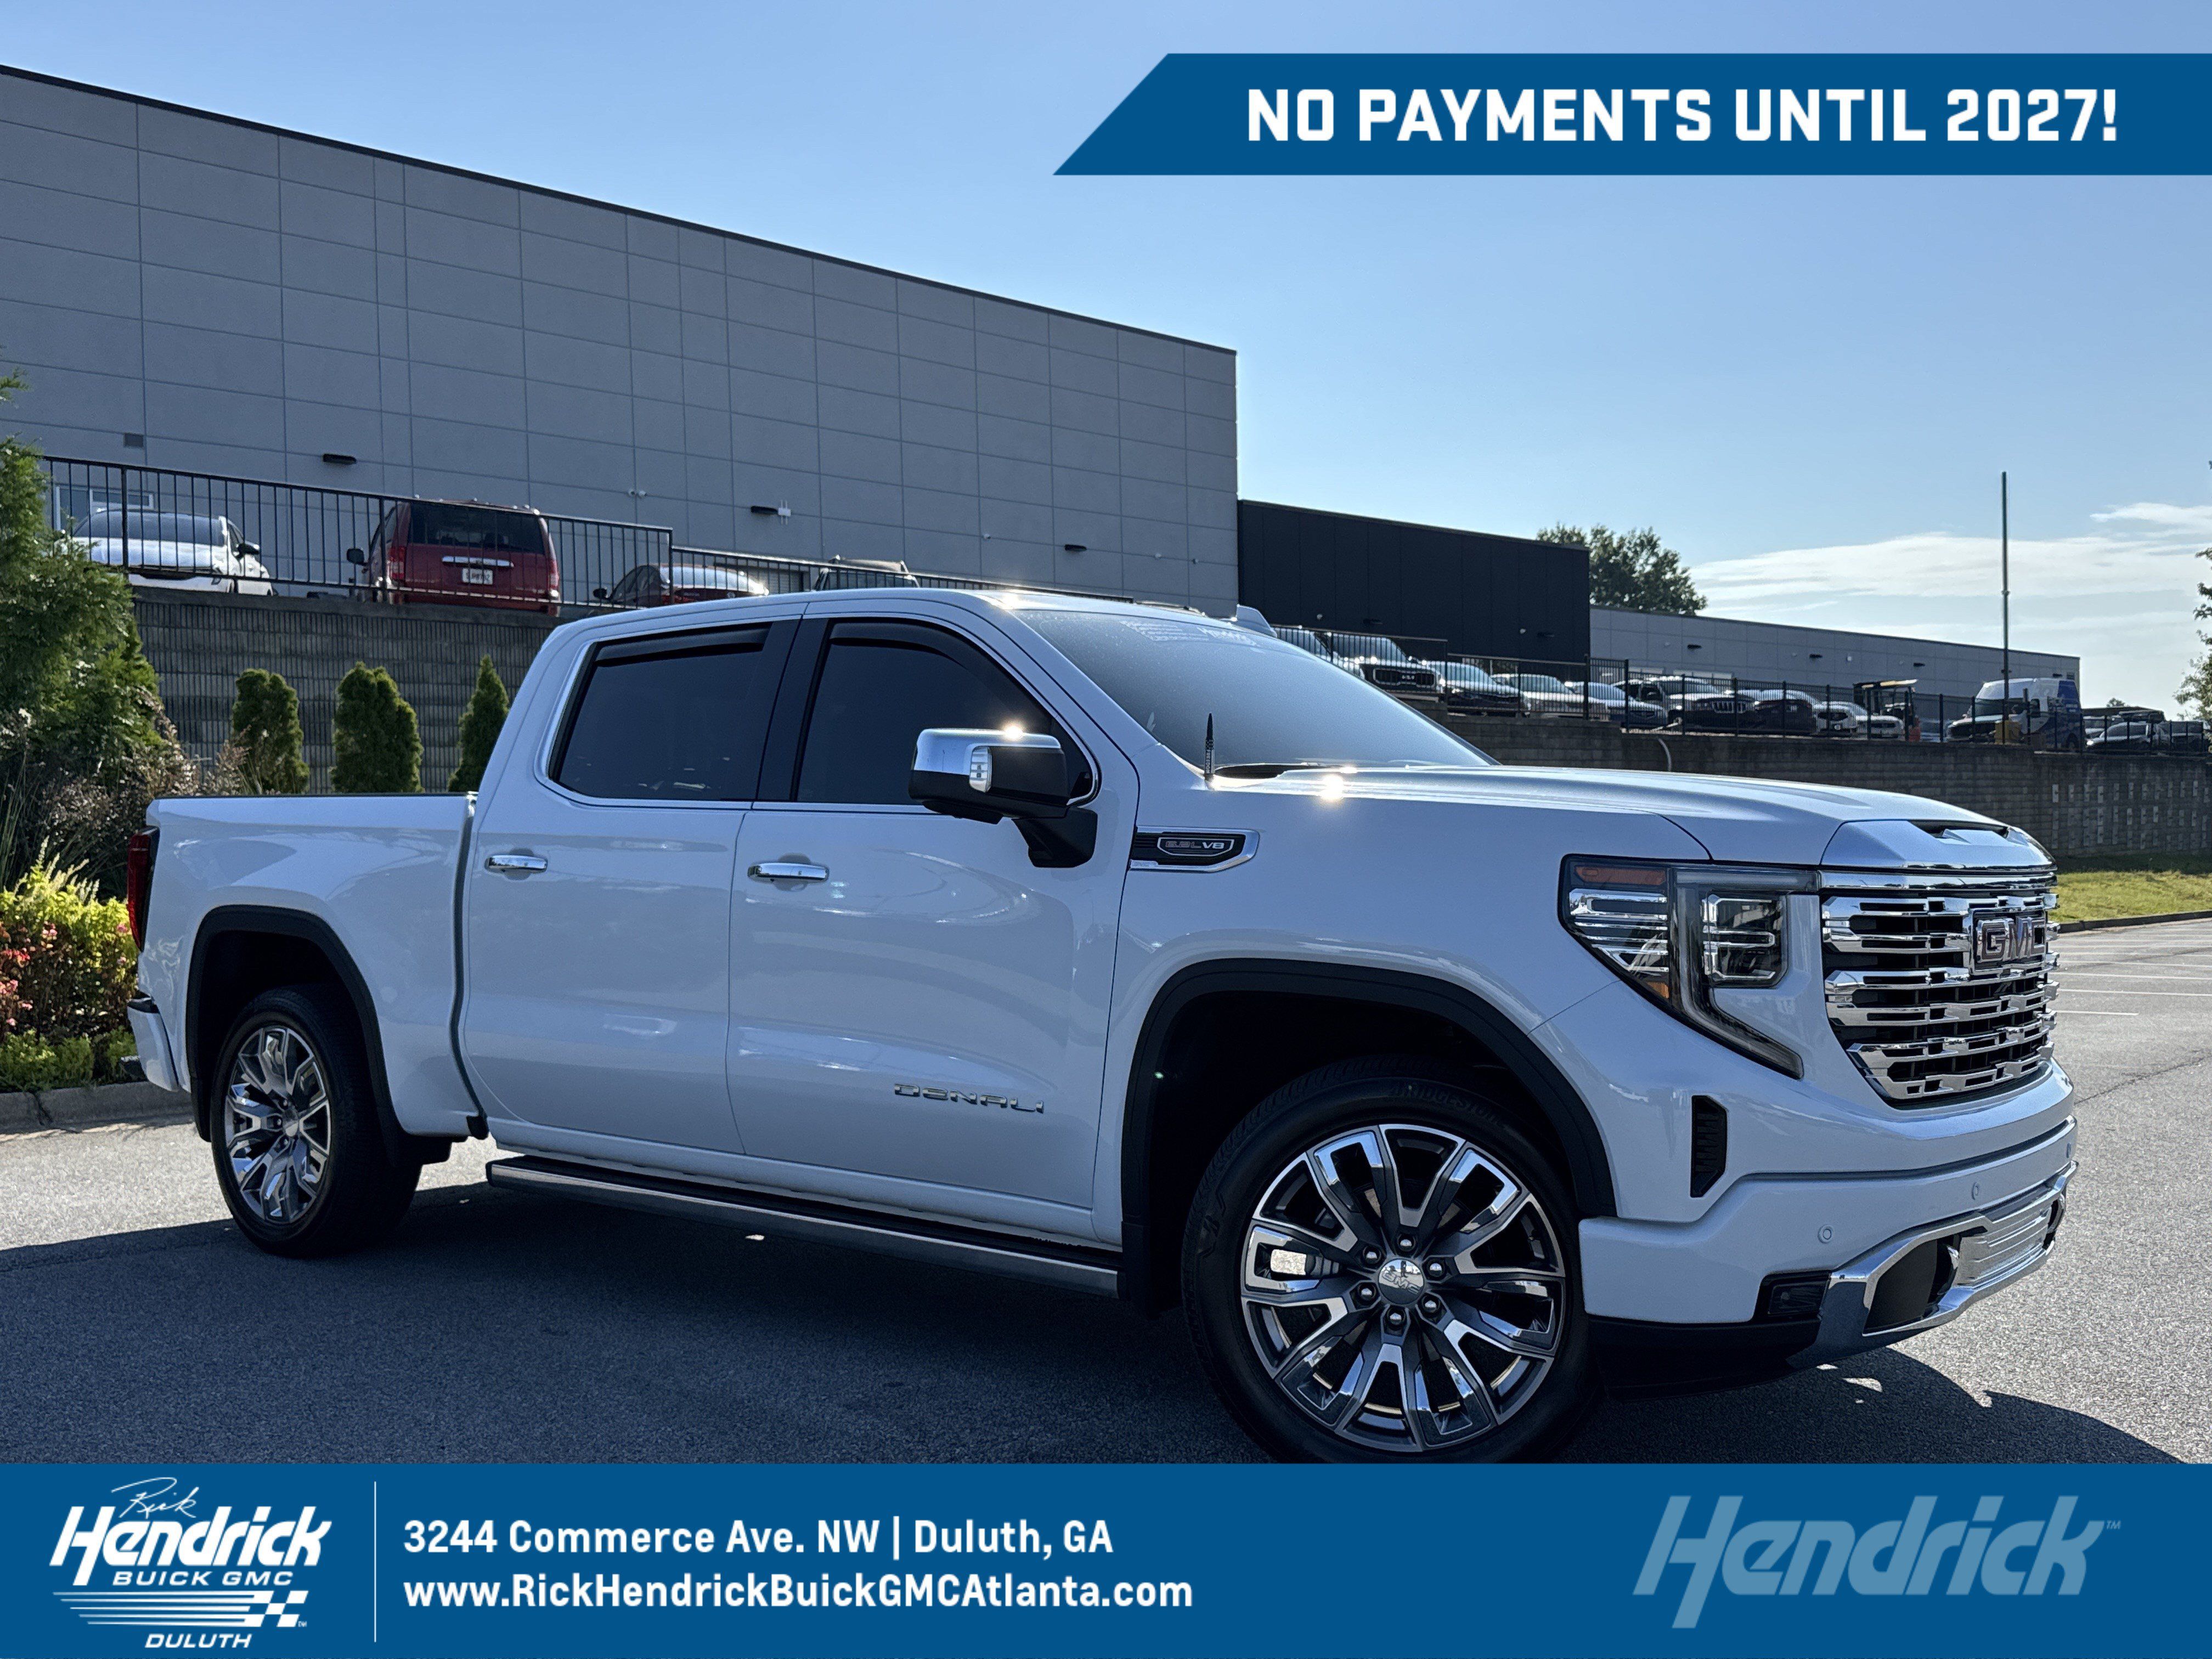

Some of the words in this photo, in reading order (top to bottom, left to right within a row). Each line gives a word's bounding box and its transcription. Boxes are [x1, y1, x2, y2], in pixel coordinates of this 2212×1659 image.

[1976, 916, 2045, 963] GMC
[894, 1083, 1045, 1115] DENALI
[1382, 1271, 1421, 1295] GMC
